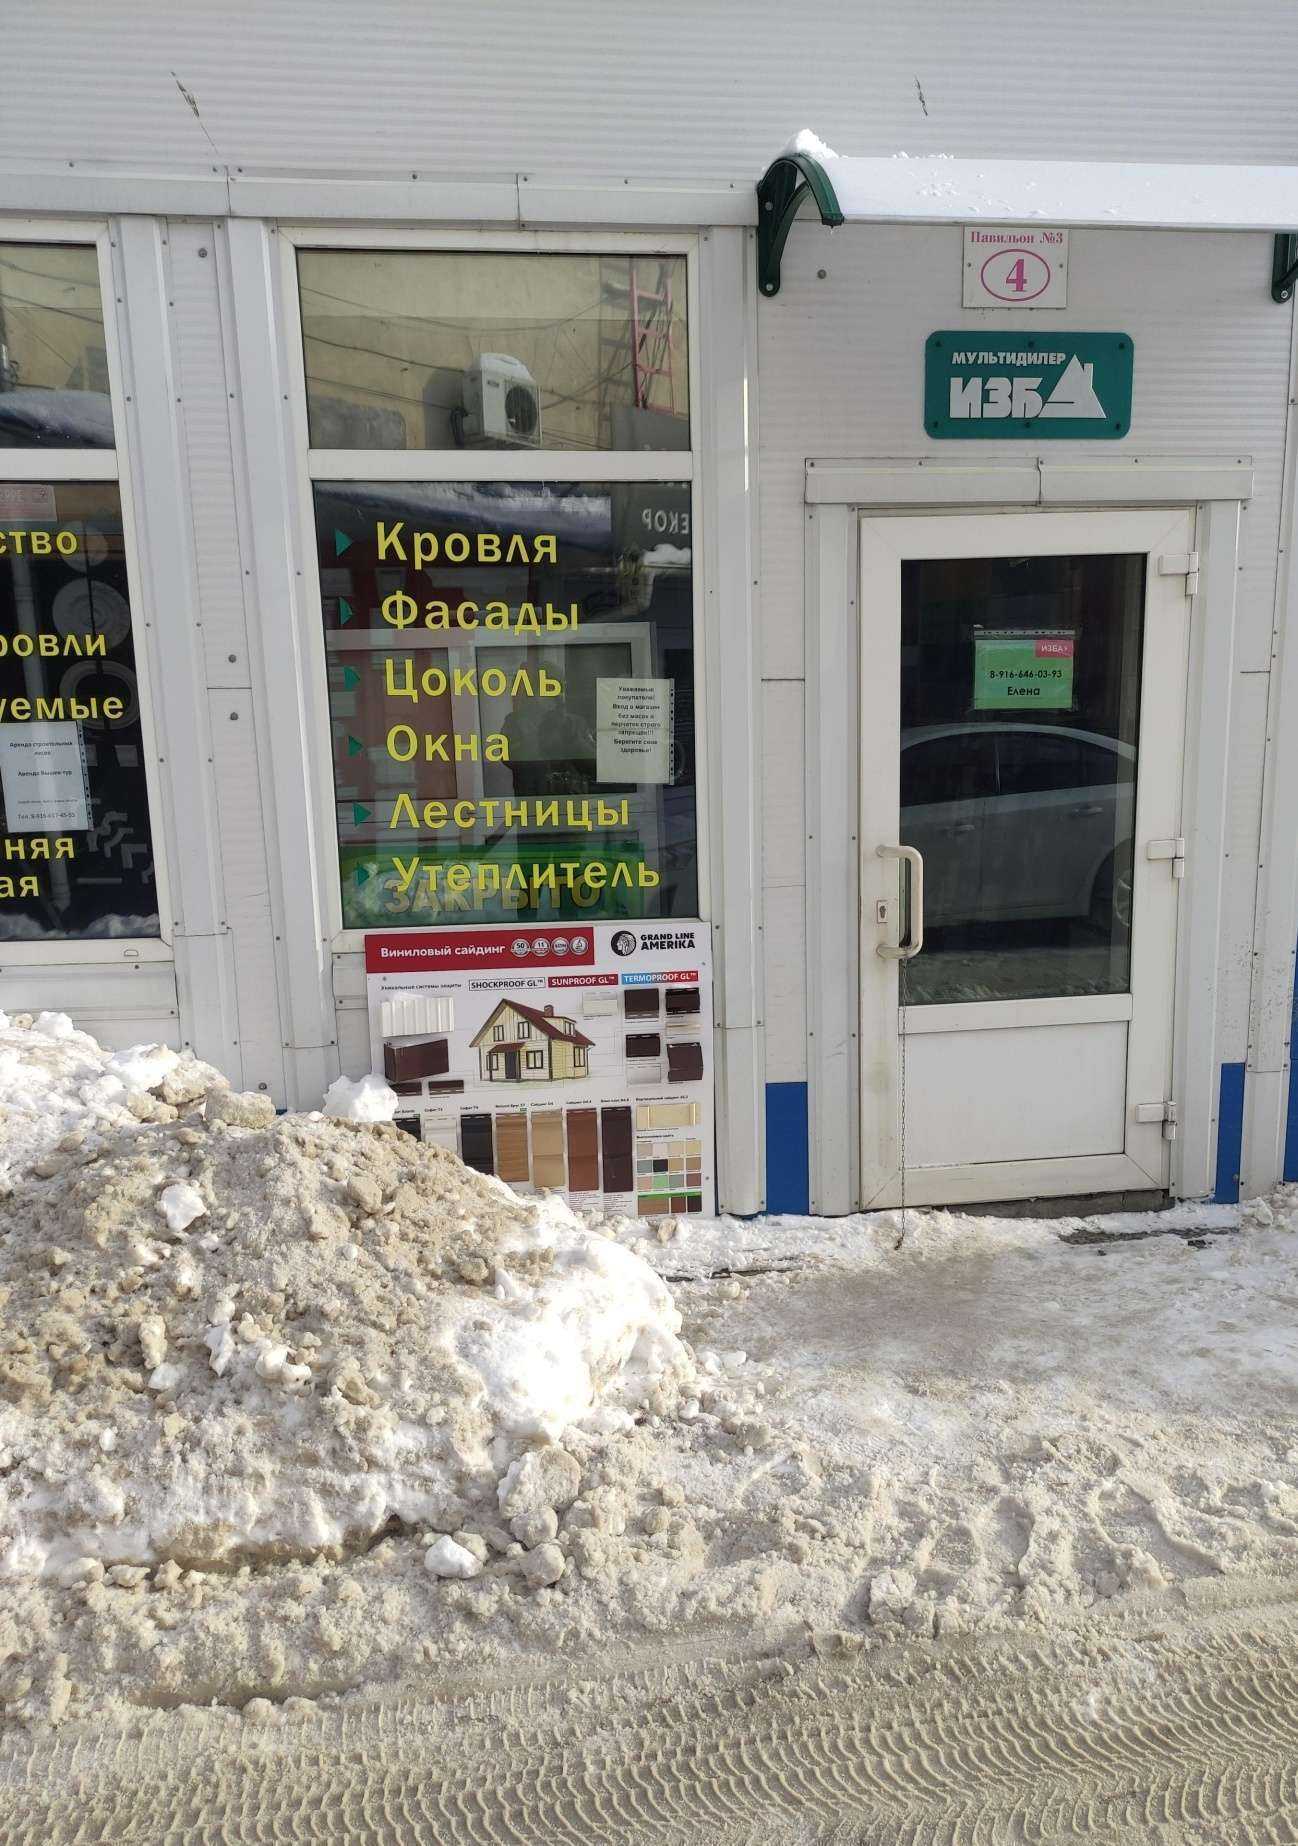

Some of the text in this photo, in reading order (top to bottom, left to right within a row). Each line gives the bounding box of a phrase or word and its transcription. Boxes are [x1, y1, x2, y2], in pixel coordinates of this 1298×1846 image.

[970, 231, 1063, 244] Павильон №3
[1006, 259, 1028, 292] 4
[952, 351, 1066, 366] МУЛЬТИДИЛЕР
[376, 521, 558, 570] Кровля
[381, 590, 579, 636] Фасады
[385, 658, 563, 704] Цоколь
[989, 670, 1062, 679] 8-916-646-03-93
[1007, 686, 1041, 696] Елена
[386, 724, 510, 763] Окна
[390, 793, 629, 831] Лестницы
[391, 856, 660, 893] Утеплитель
[383, 873, 601, 913] ЗАКРЫТО
[640, 932, 695, 941] GRAND LINE
[380, 944, 506, 958] Виниловый сайдинг
[516, 942, 525, 950] 50
[640, 940, 696, 951] AMERIKA
[471, 980, 526, 990] SHOCKPROOF
[551, 977, 597, 986] SUNPROOF
[624, 974, 679, 983] TERMOPROOF
